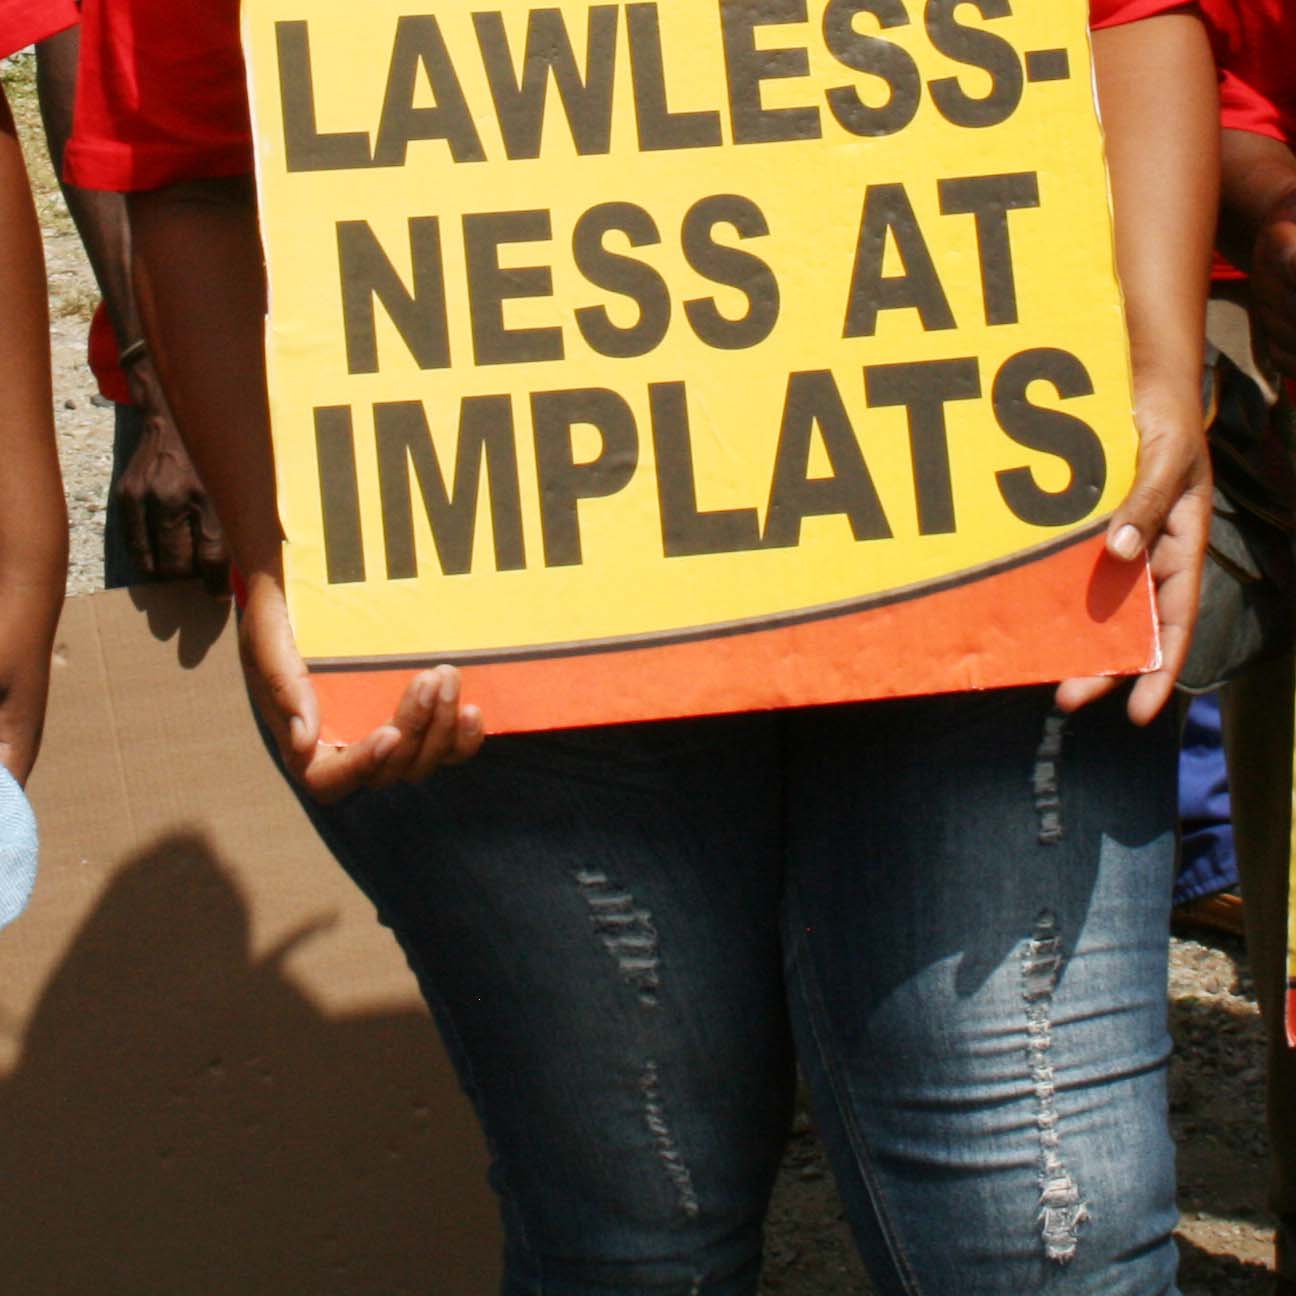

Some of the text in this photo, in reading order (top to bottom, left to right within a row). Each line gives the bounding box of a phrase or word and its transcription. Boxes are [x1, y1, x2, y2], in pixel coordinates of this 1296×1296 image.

[335, 171, 1040, 375] NESS AT
[313, 346, 1108, 585] IMPLATS
